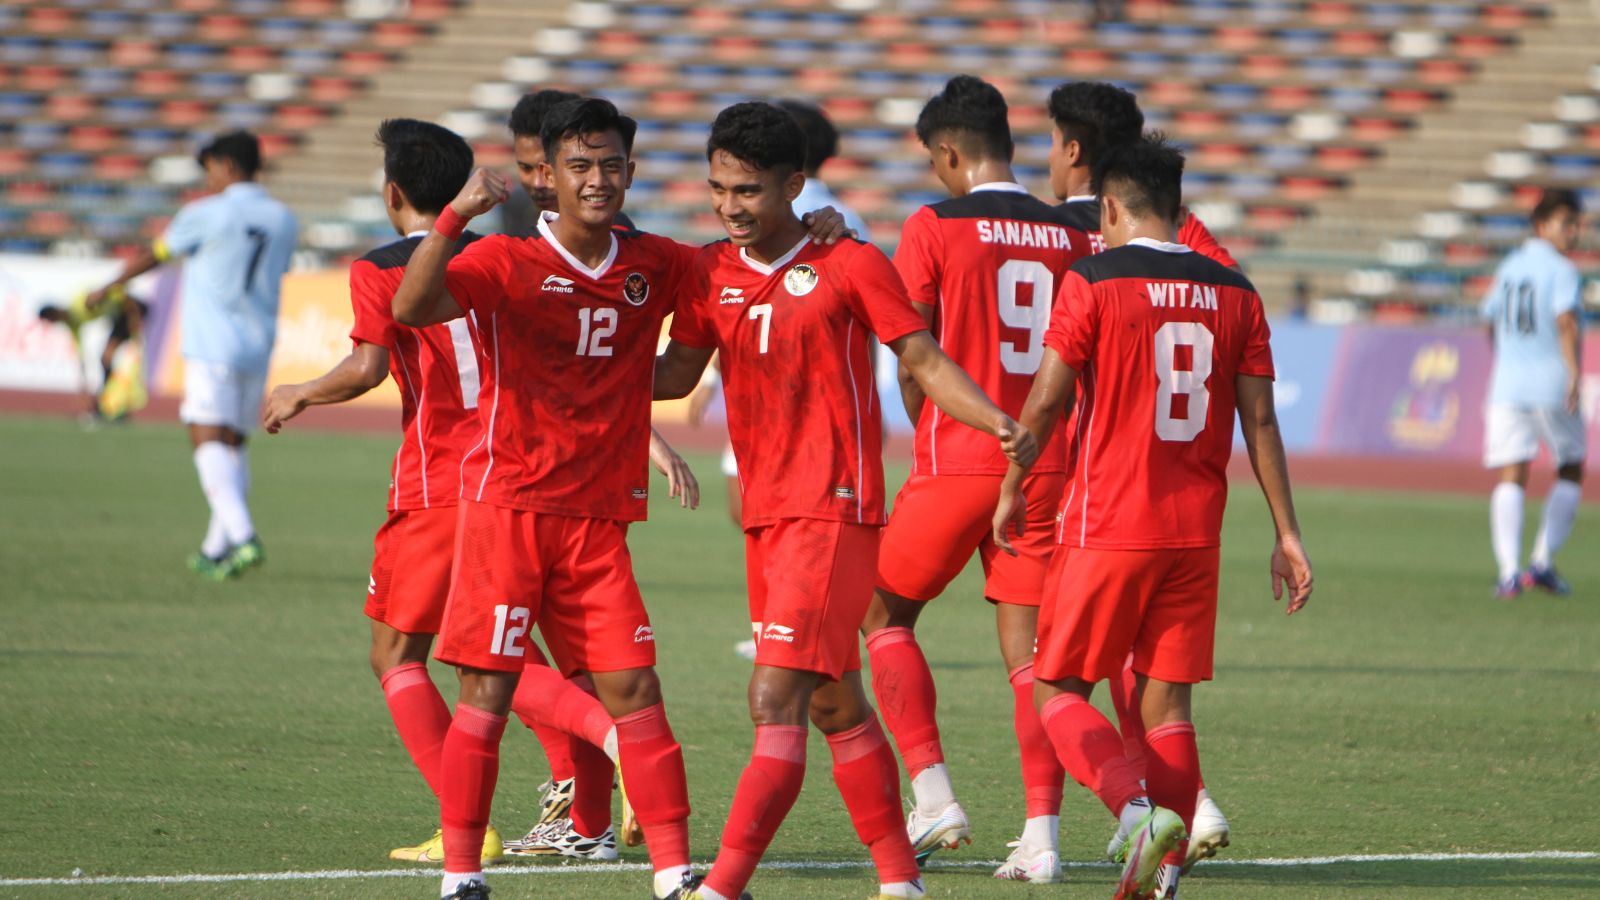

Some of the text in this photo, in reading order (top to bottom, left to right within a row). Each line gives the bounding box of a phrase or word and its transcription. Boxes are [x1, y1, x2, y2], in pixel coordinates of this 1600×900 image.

[976, 220, 1072, 250] SANANTA
[245, 226, 268, 296] 7
[541, 284, 574, 294] LI-NING
[1146, 283, 1218, 310] WITAN
[576, 307, 618, 356] 12
[749, 303, 773, 354] 7
[998, 259, 1054, 375] 9
[1154, 322, 1215, 441] 8
[490, 604, 530, 656] 12
